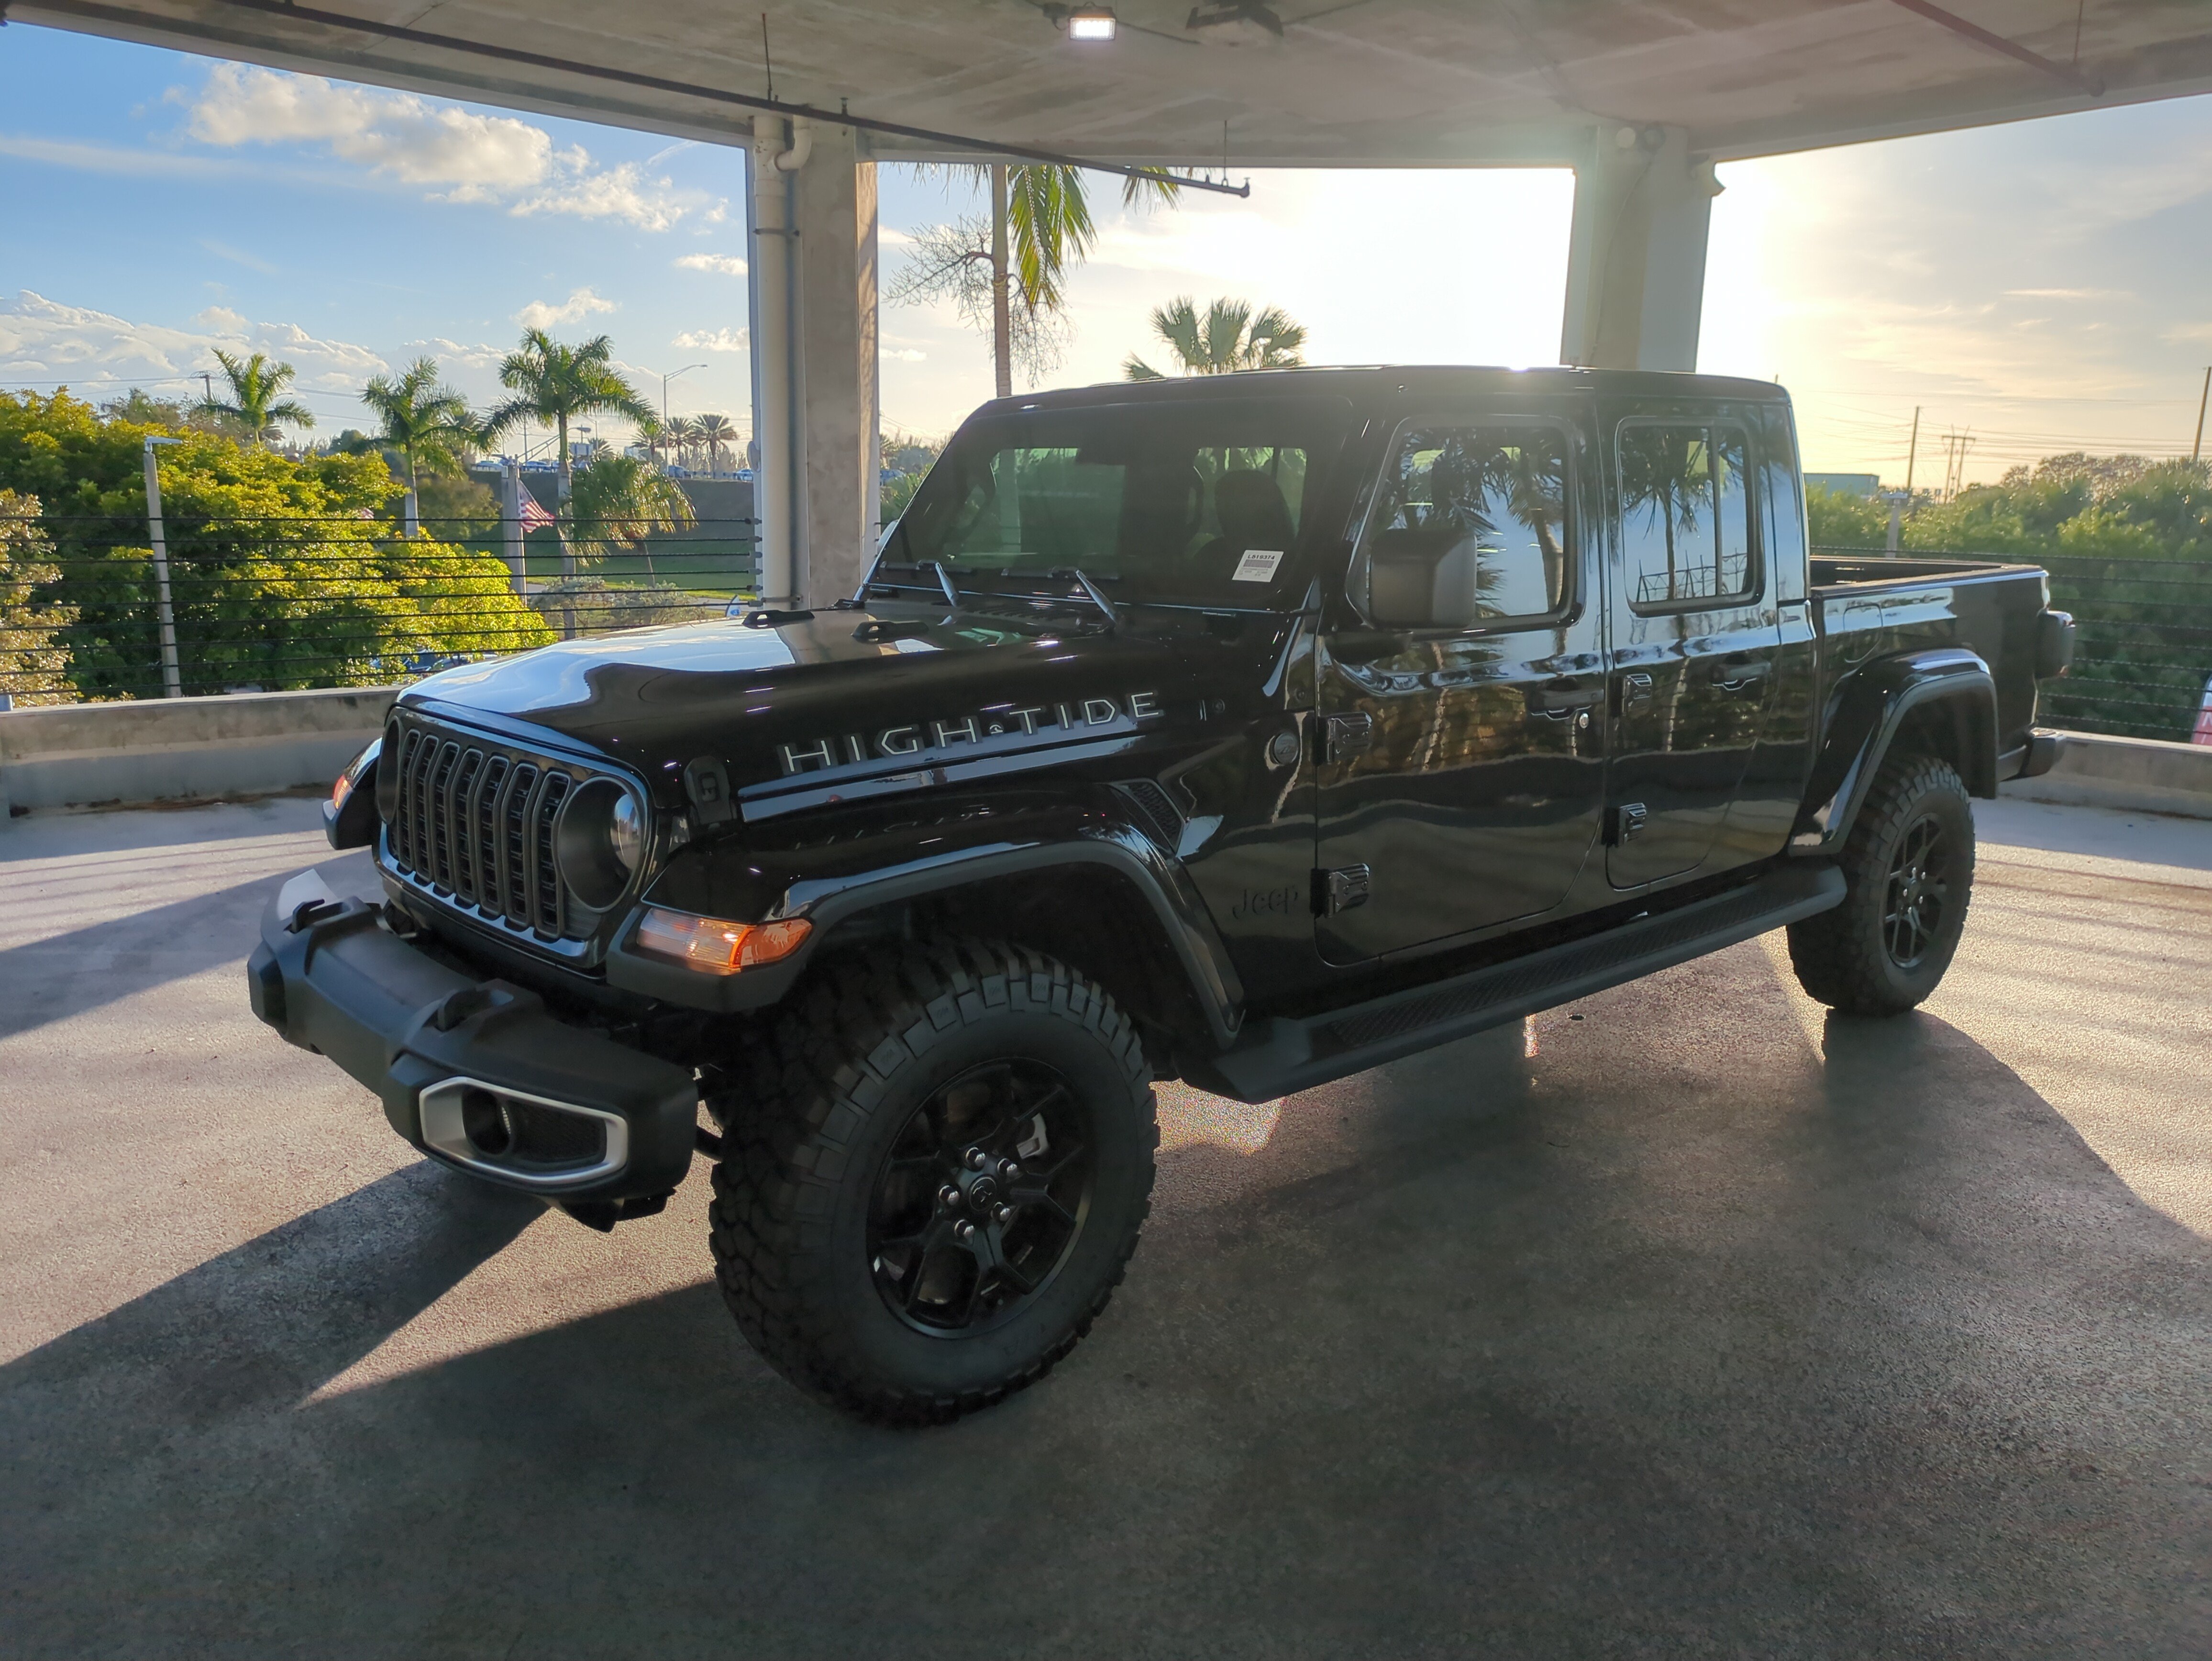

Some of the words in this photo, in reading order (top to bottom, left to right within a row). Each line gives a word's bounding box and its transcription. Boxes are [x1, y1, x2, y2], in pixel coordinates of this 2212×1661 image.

[777, 716, 982, 775] HIGH
[1003, 690, 1164, 736] TIDE
[1232, 887, 1298, 919] Jeep
